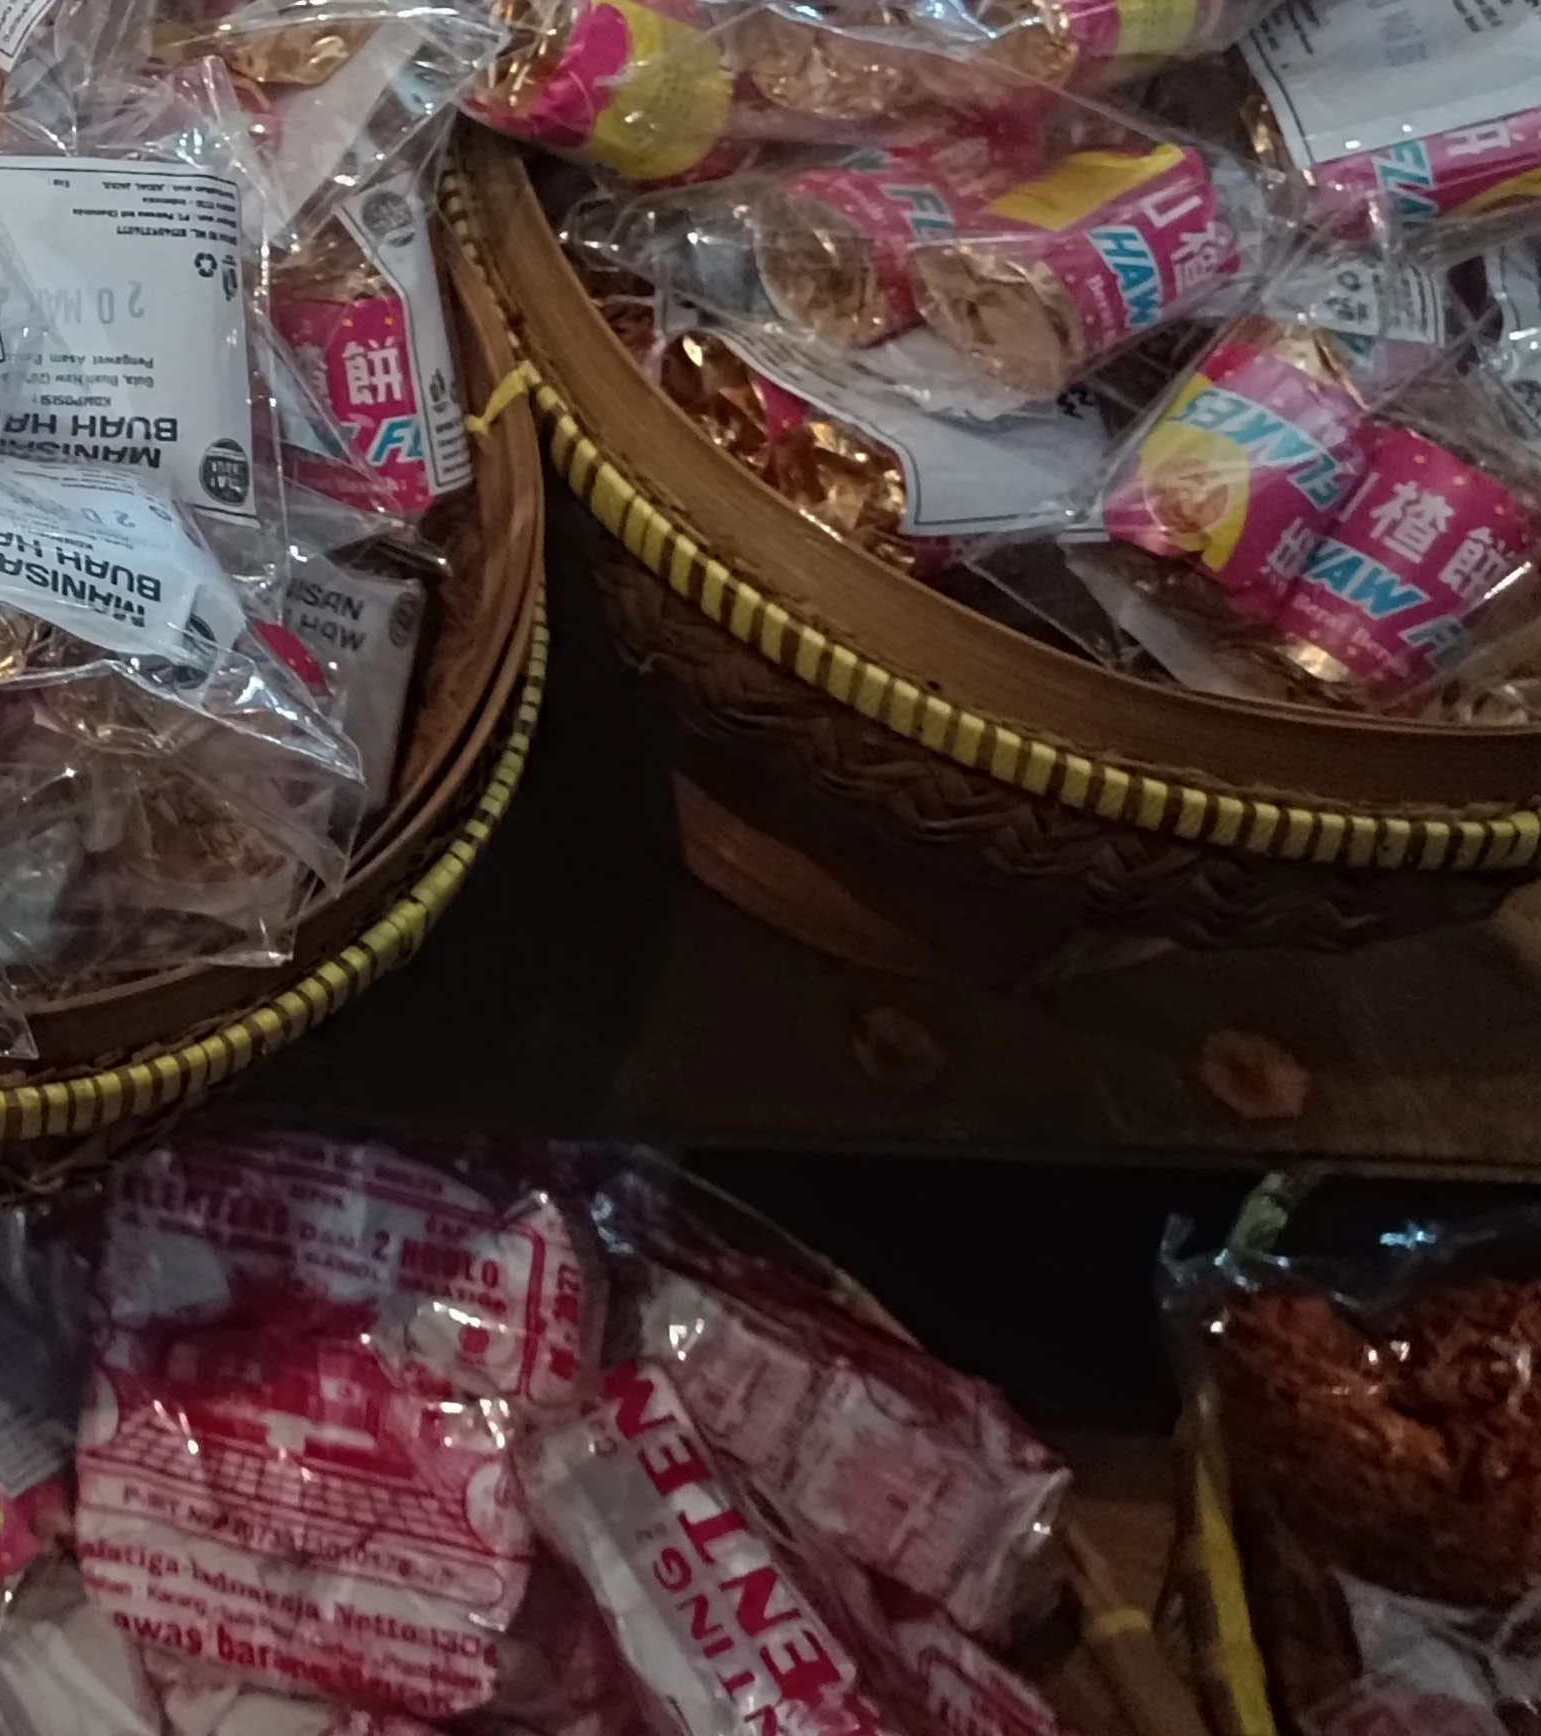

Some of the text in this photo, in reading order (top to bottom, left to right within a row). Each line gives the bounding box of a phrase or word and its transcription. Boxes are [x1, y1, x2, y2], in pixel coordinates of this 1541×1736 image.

[1086, 211, 1178, 332] HAW
[70, 413, 178, 442] BUAH
[52, 544, 165, 603] BUAH
